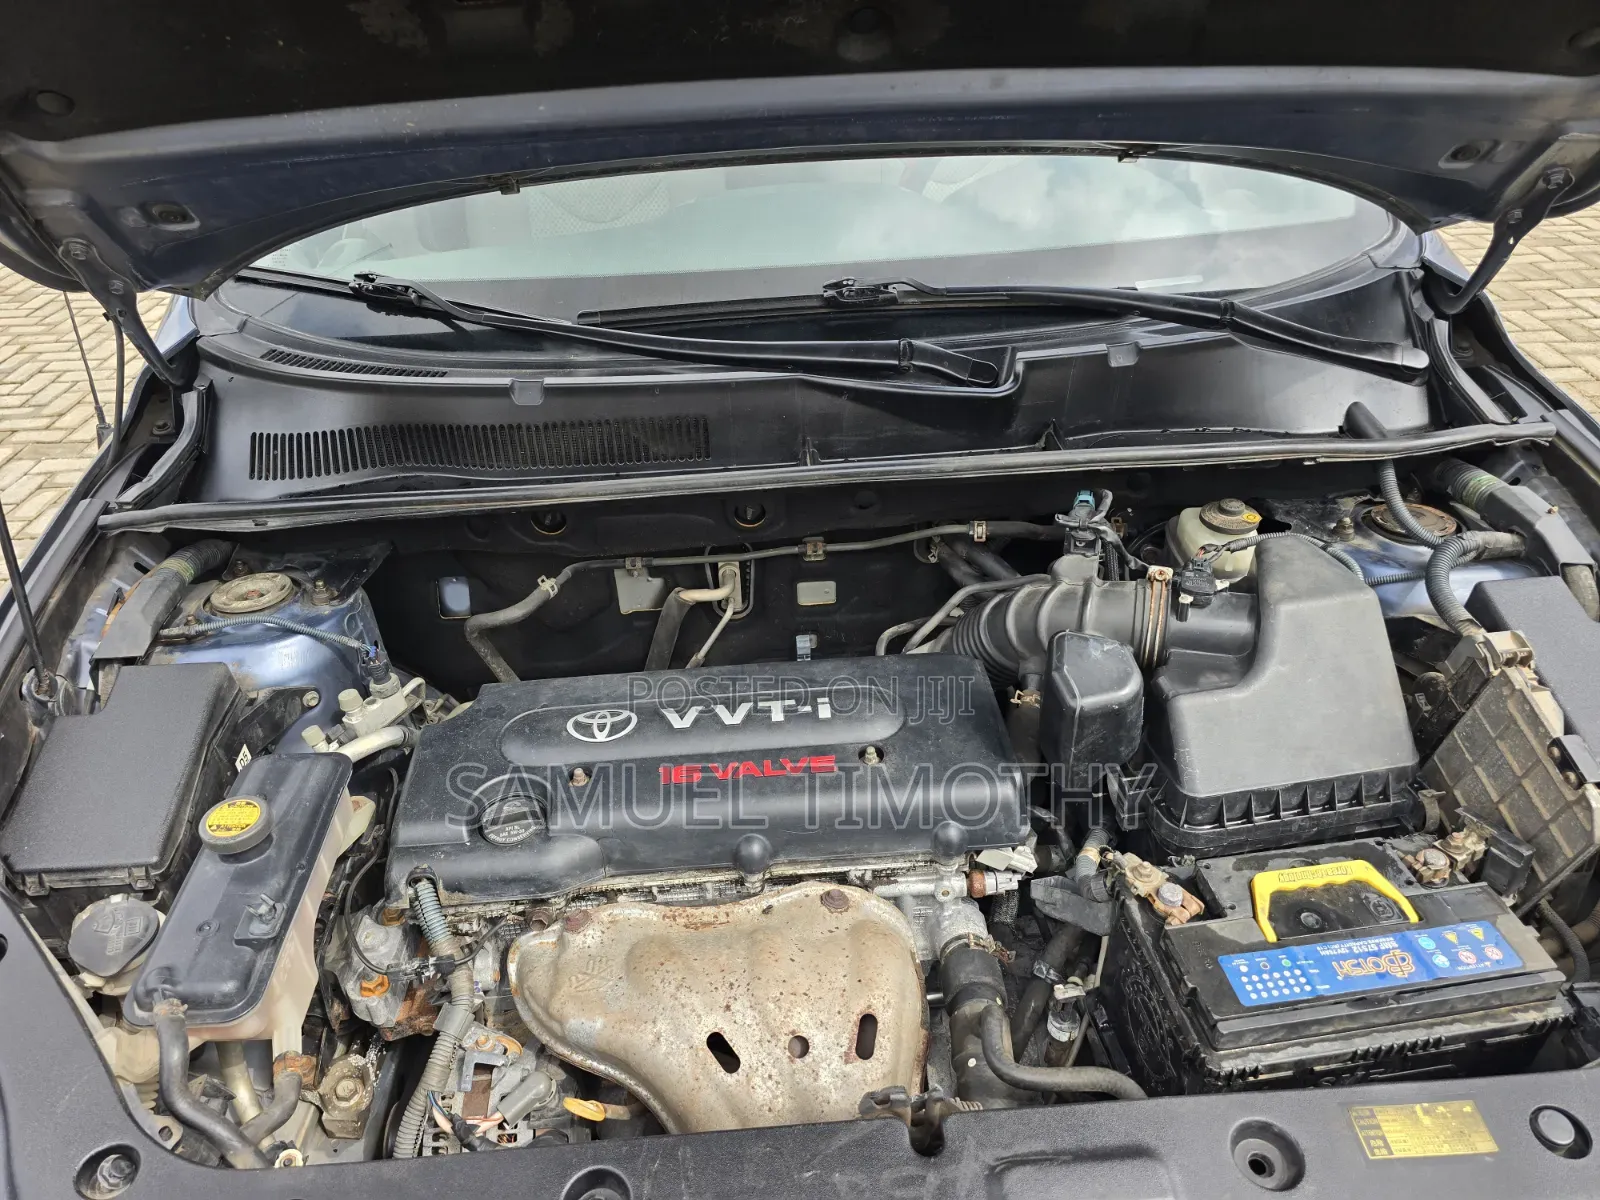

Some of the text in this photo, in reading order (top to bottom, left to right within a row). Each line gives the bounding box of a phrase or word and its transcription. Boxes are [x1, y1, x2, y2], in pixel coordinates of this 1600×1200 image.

[661, 698, 832, 729] VVT-i
[659, 755, 838, 785] 16 VALVE
